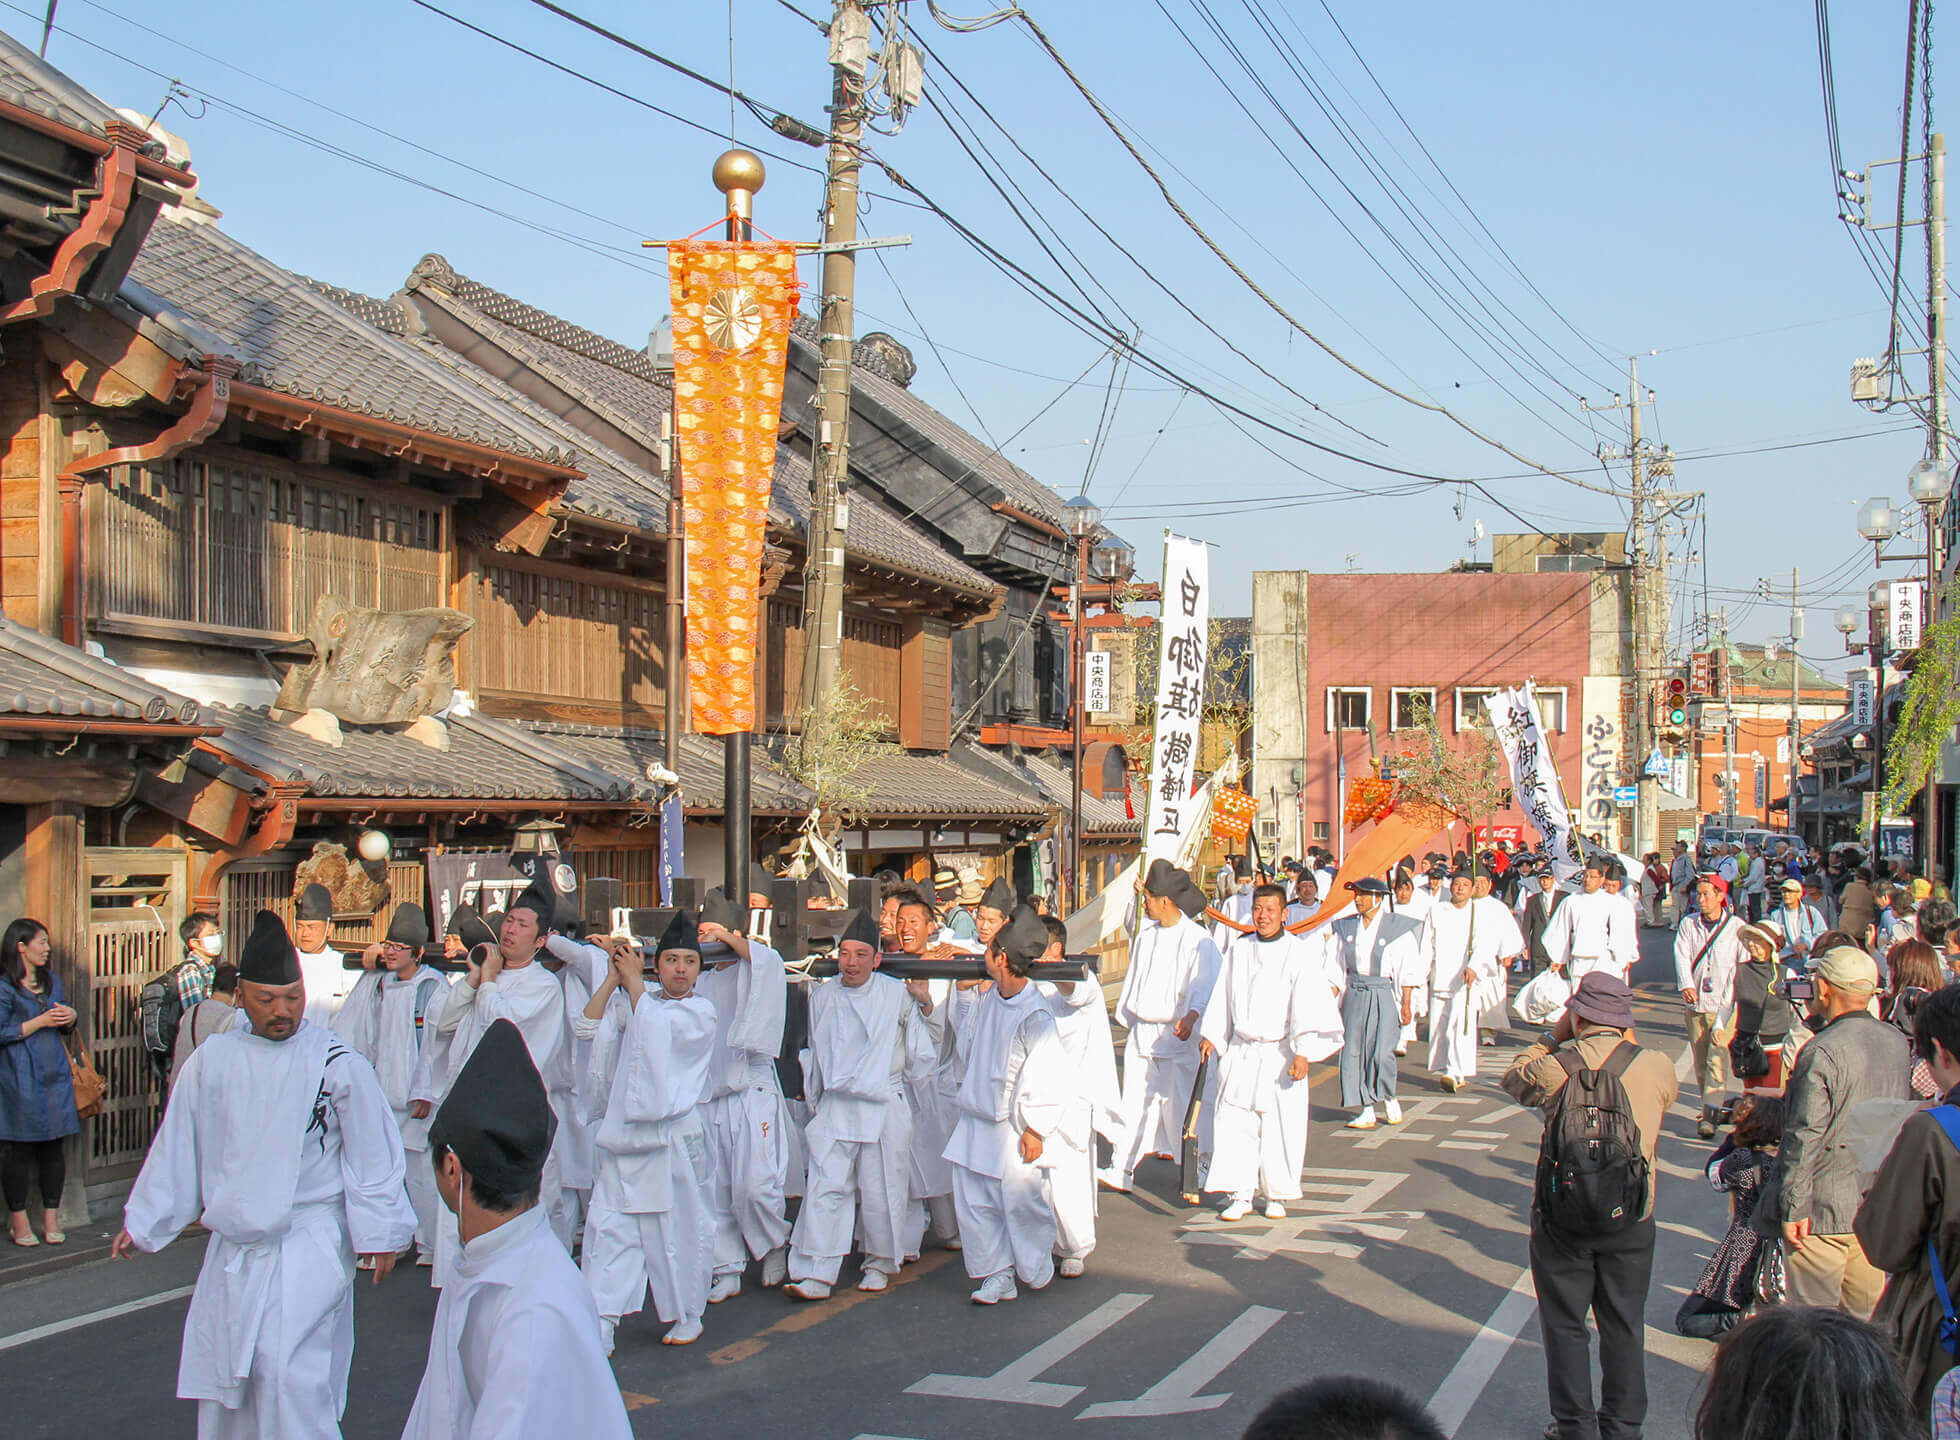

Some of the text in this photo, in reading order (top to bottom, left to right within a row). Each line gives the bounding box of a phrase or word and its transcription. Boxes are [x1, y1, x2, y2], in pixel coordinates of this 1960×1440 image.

[1897, 585, 1913, 648] 中央商店街
[1091, 653, 1104, 710] 中央商店街
[1858, 682, 1869, 724] 中央商店街
[1479, 827, 1518, 839] Coa-Cola
